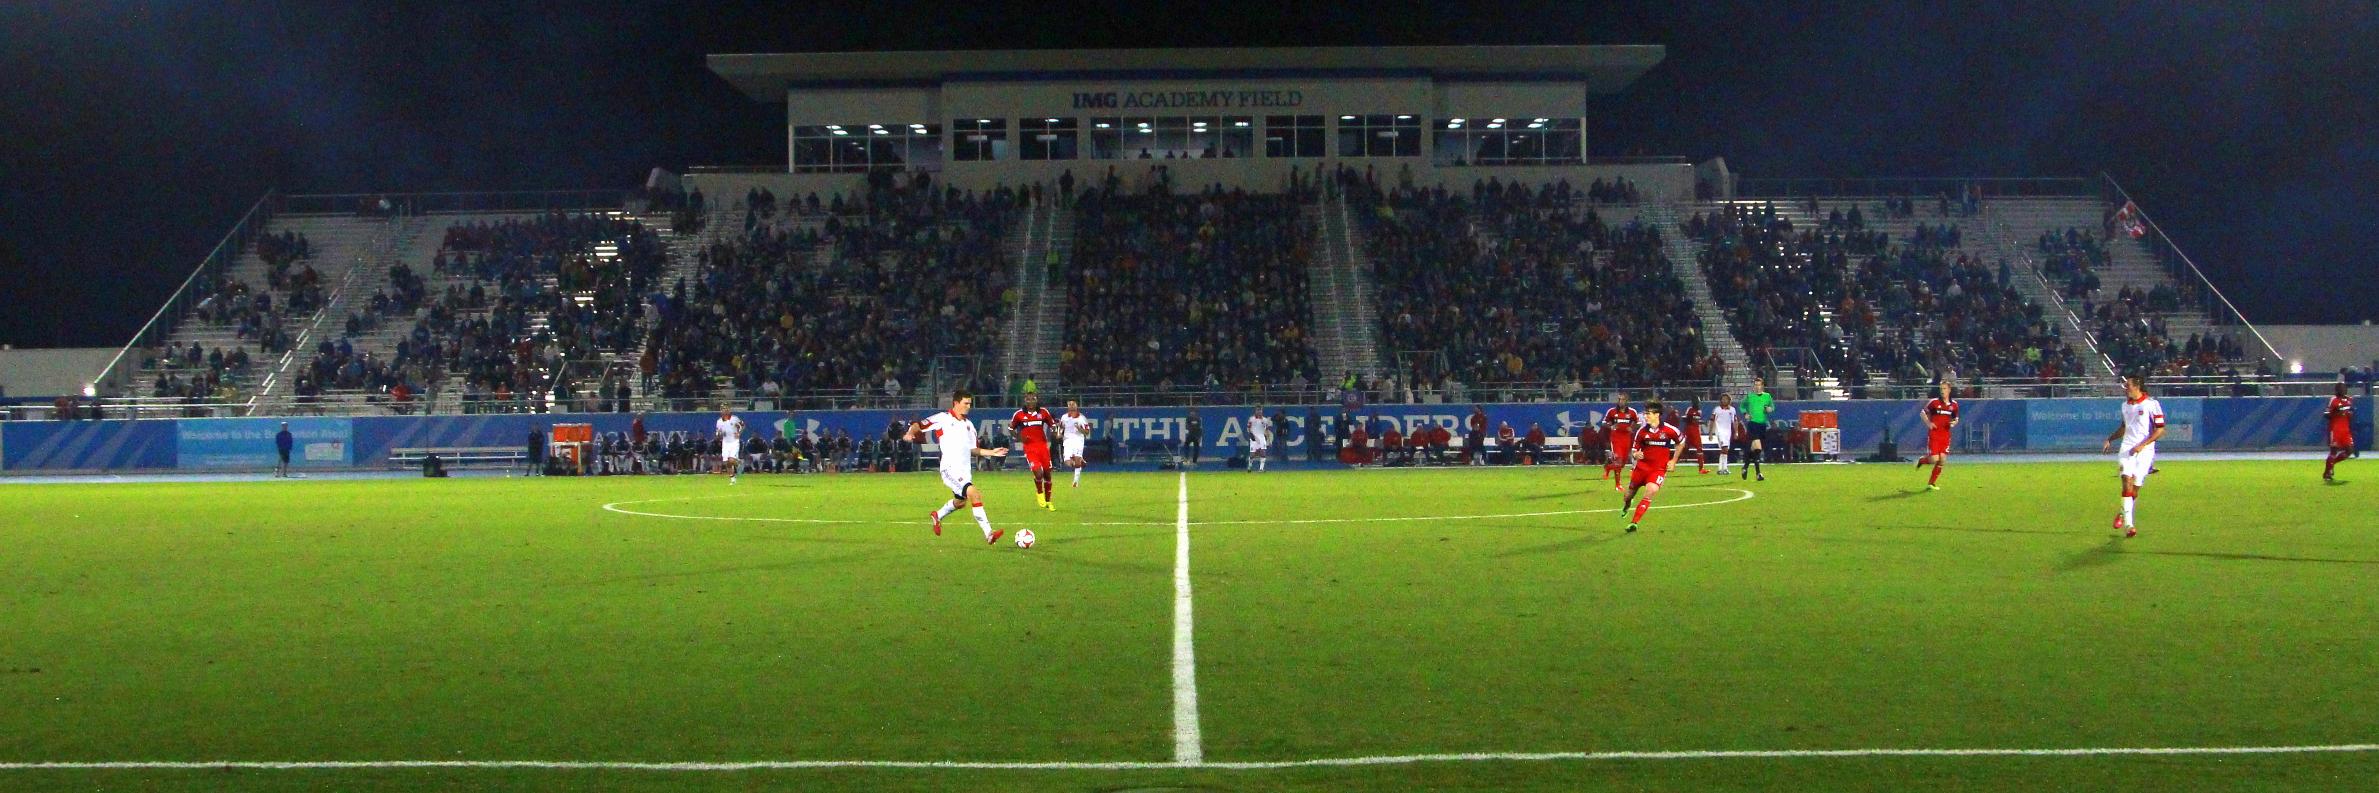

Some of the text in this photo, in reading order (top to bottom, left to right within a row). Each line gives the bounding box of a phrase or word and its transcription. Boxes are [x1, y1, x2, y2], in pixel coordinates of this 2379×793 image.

[1073, 91, 1303, 108] IMG ACADEMY FIELD
